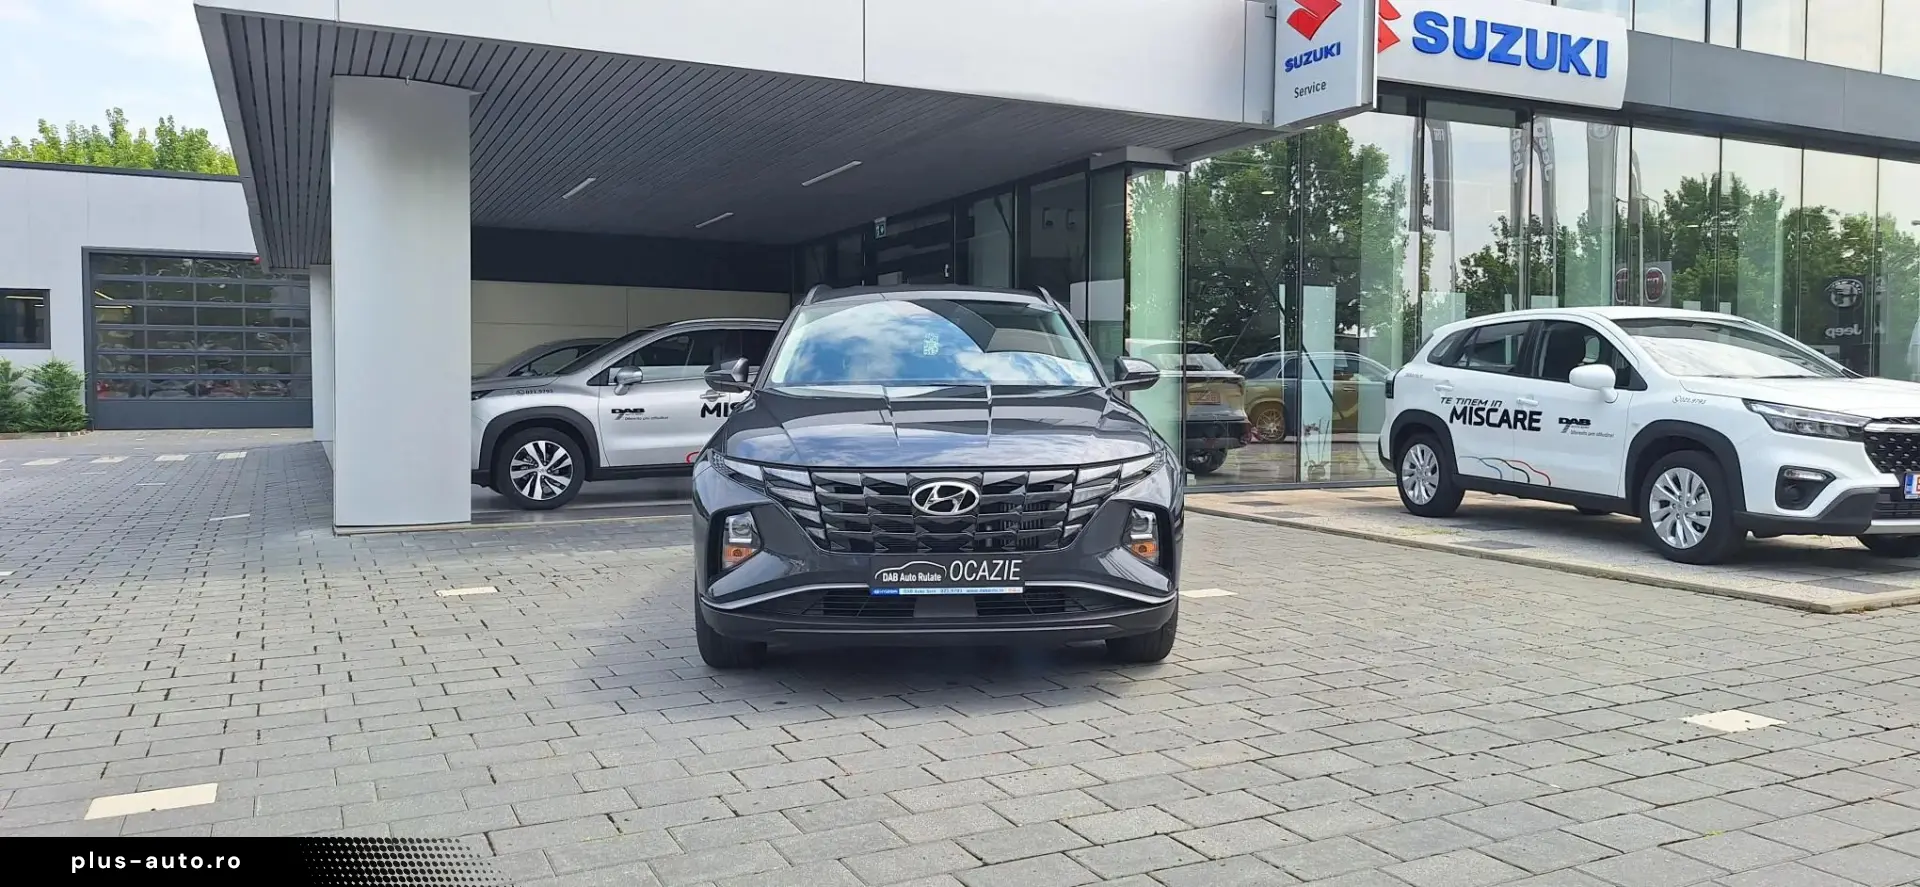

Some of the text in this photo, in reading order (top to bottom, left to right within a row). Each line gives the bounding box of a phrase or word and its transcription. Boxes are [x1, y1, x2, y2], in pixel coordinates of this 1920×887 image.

[1412, 10, 1609, 79] SUZUKI
[1284, 41, 1341, 72] SUZUKI
[1294, 79, 1327, 99] Service
[1440, 396, 1453, 405] TE
[1449, 405, 1543, 432] MISCARE
[1558, 417, 1591, 426] DAB
[882, 572, 942, 582] DAB Auto Rulate
[949, 559, 1023, 581] OCAZIE
